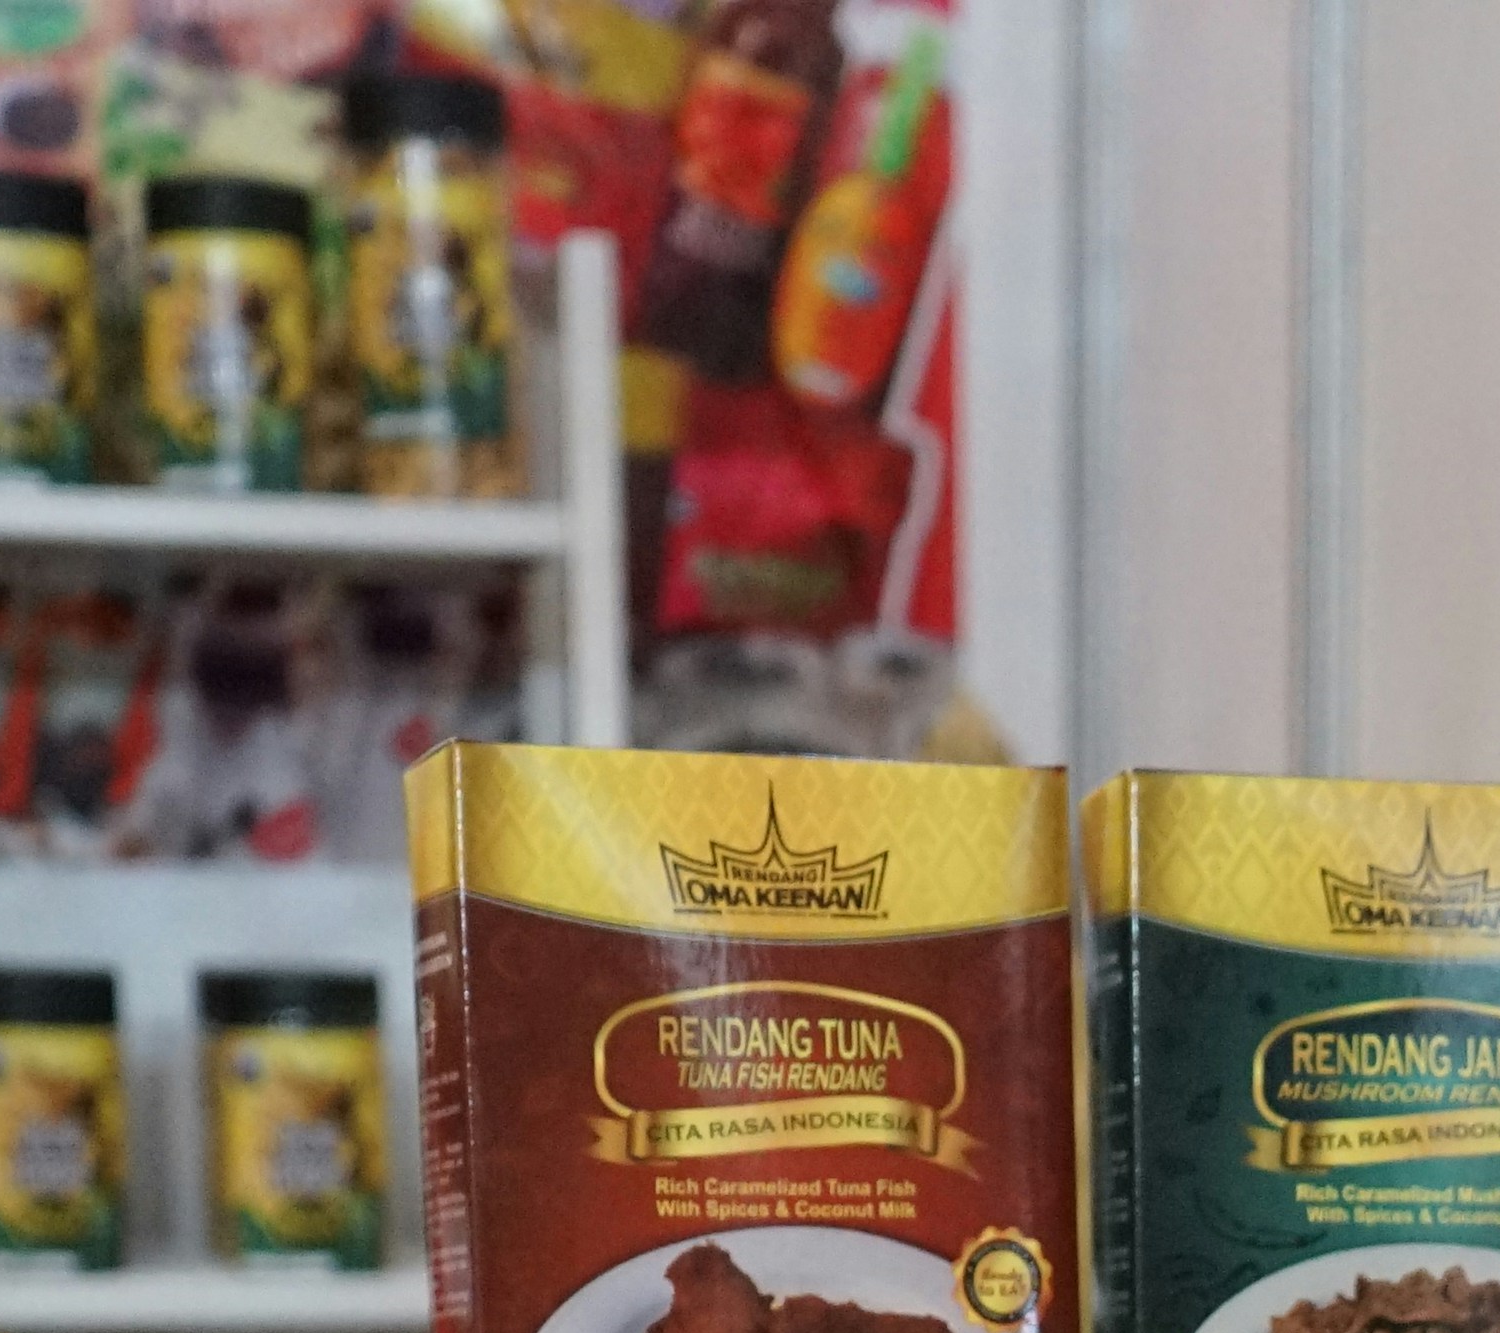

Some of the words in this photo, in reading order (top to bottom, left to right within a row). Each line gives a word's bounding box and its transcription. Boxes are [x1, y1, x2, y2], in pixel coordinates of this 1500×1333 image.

[733, 866, 818, 885] RENDANG
[687, 879, 752, 907] OMA
[756, 883, 865, 909] KEENAN
[1344, 902, 1405, 927] OMA
[659, 1015, 812, 1058] RENDANG
[818, 1018, 902, 1060] TUNA
[1293, 1034, 1452, 1078] RENDANG
[678, 1061, 732, 1089] TUNA
[736, 1063, 784, 1090] FISH
[787, 1064, 887, 1092] RENDANG
[1278, 1082, 1444, 1103] MUSHROOM
[648, 1121, 703, 1144] CITA
[709, 1116, 776, 1139] RASA
[782, 1109, 920, 1134] INDONESIA
[1358, 1126, 1423, 1148] RASA
[655, 1176, 699, 1196] Rich
[704, 1177, 821, 1197] Caramelized
[827, 1178, 872, 1197] Tuna
[876, 1179, 917, 1197] Fish
[655, 1199, 699, 1218] With
[705, 1199, 770, 1221] Spices
[775, 1200, 789, 1218] &
[794, 1200, 873, 1219] Coconut
[878, 1201, 917, 1219] Milk
